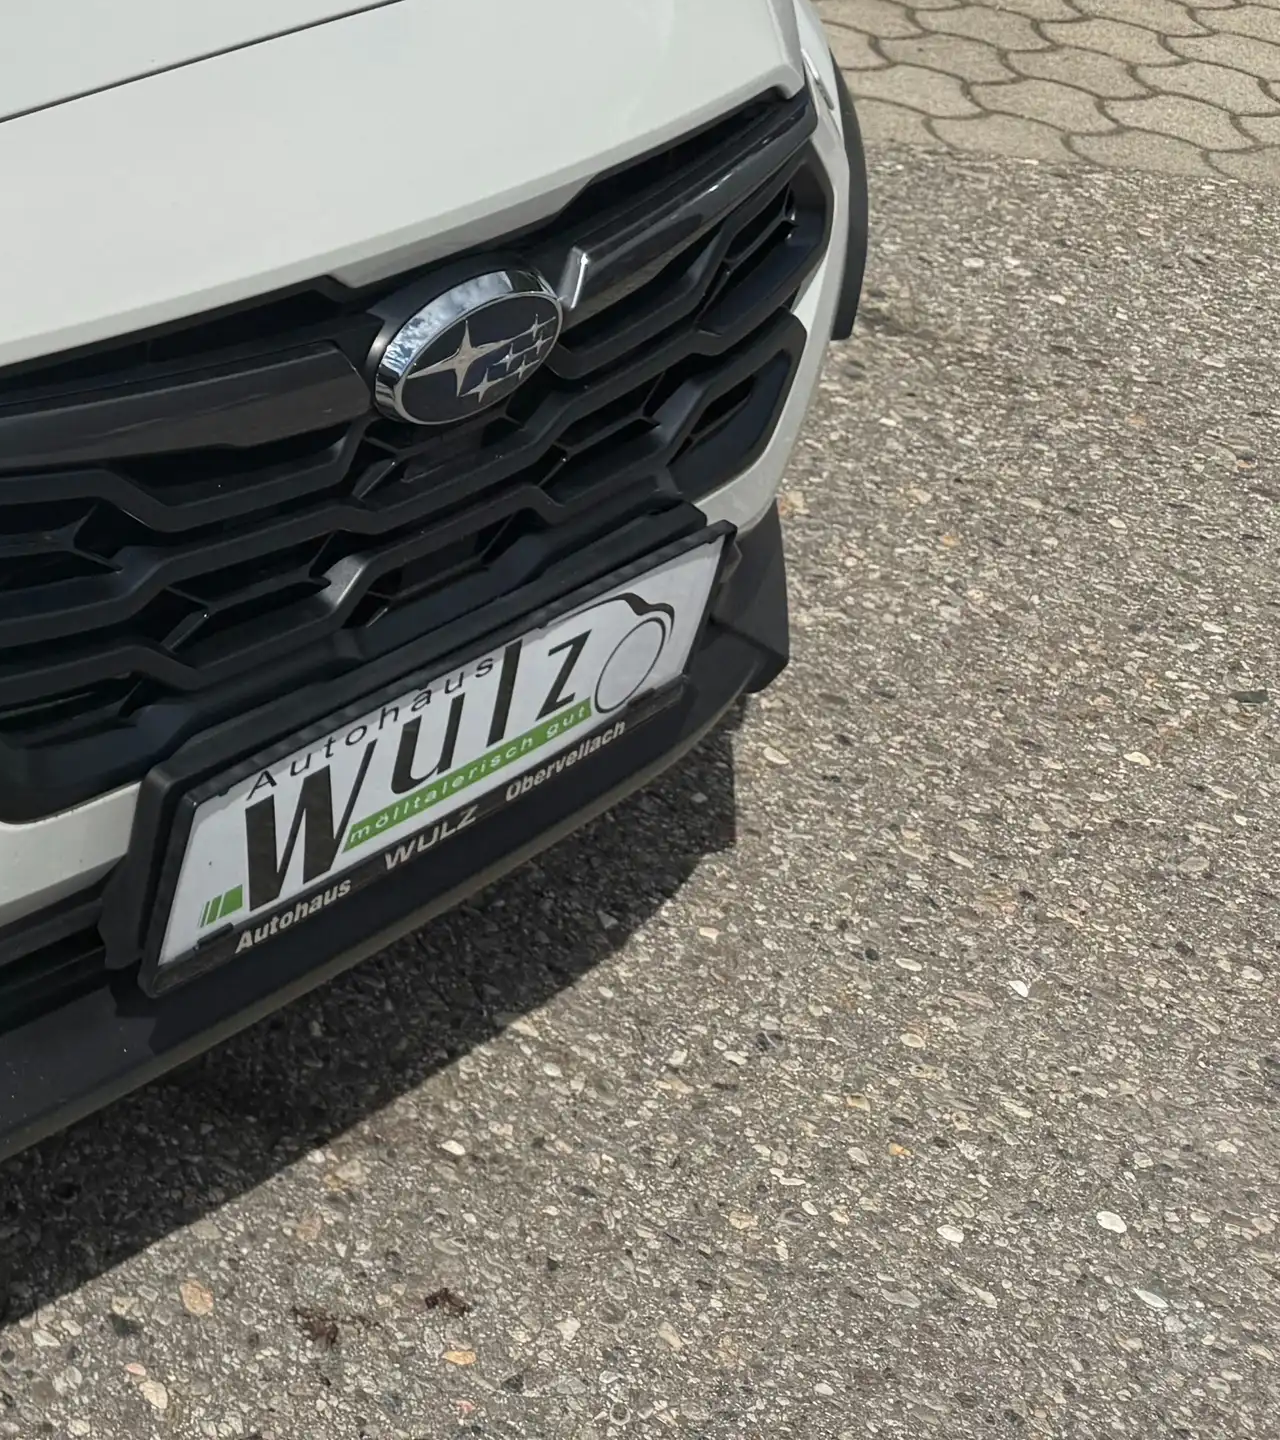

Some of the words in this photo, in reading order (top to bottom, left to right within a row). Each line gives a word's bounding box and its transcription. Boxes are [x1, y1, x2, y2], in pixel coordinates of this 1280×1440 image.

[247, 657, 494, 800] Autohaus
[350, 732, 534, 845] mölltalerisch
[546, 704, 587, 739] gut
[236, 877, 352, 953] Autohaus
[384, 805, 478, 870] WULZ
[504, 720, 626, 802] Obervellach
